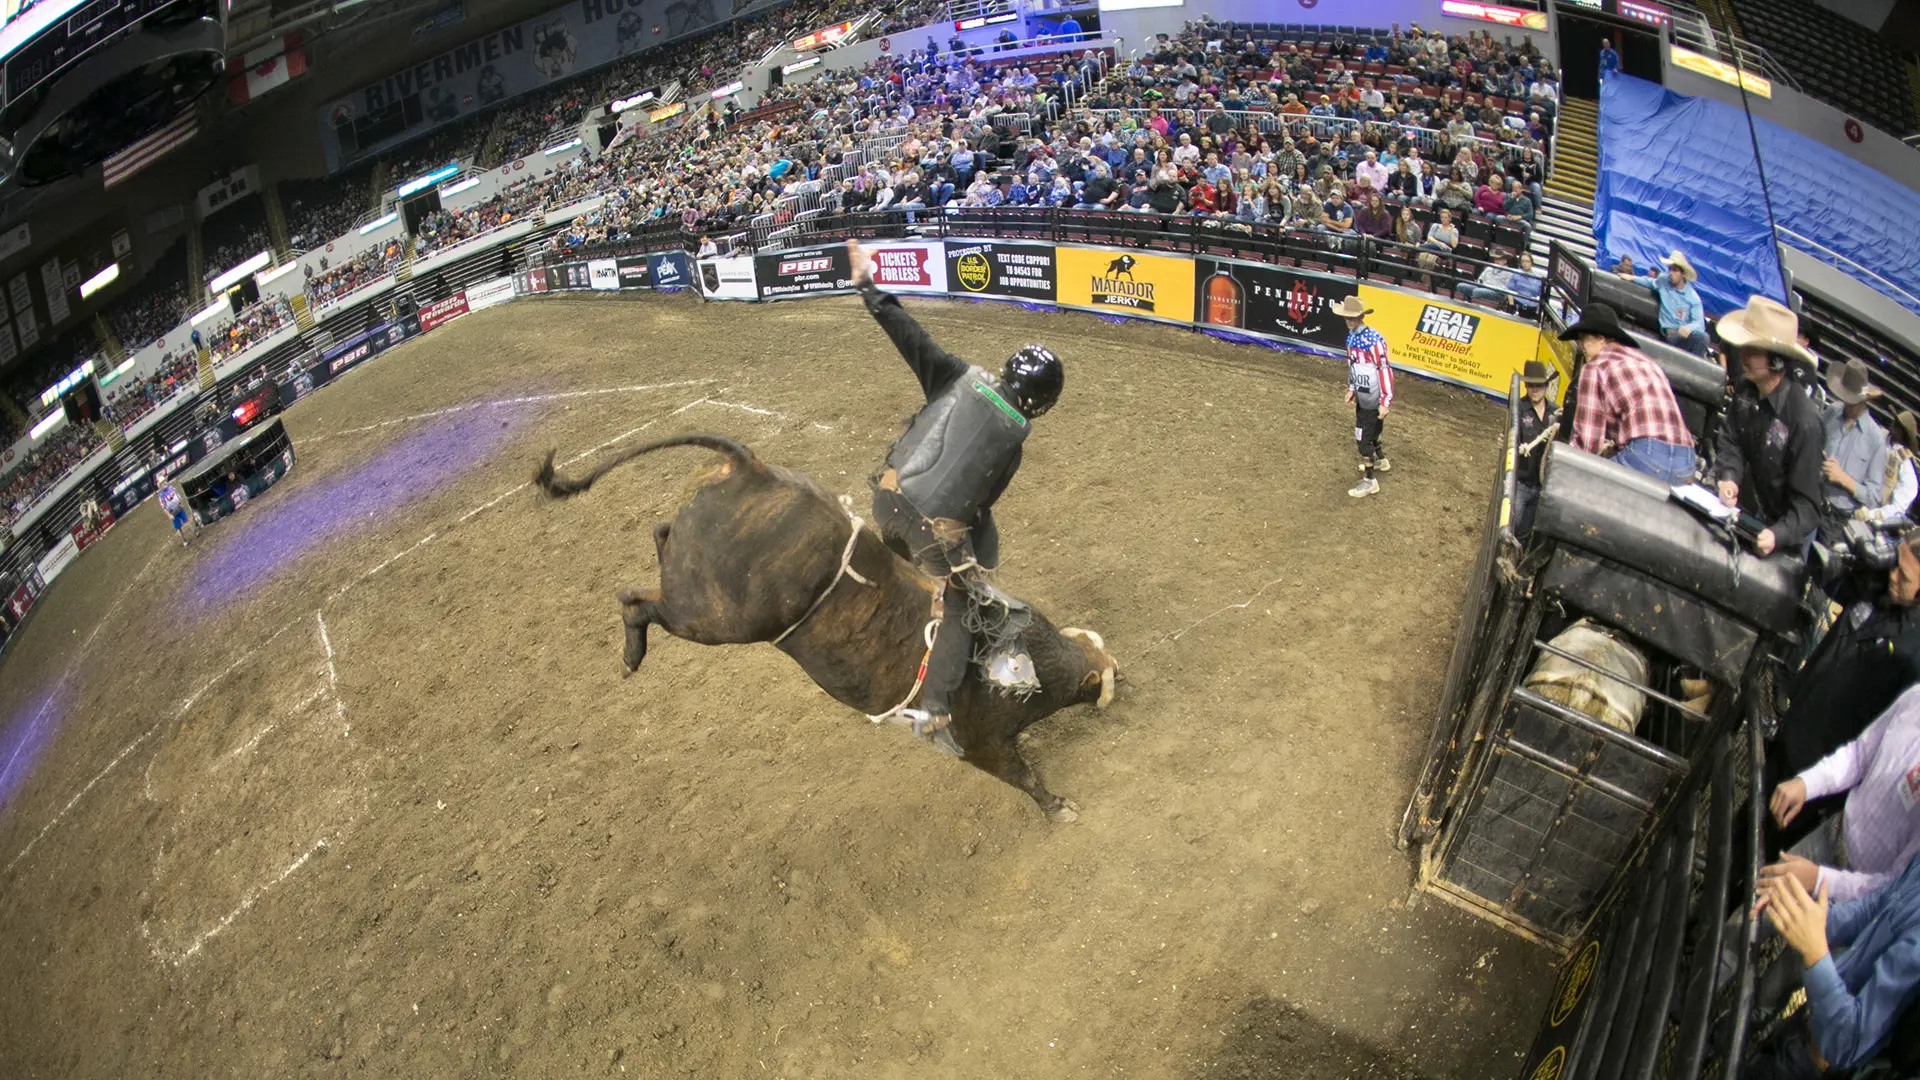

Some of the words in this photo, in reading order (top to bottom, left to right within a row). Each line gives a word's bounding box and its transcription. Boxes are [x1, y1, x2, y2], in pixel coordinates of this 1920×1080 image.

[364, 25, 525, 113] RIVERMEN
[878, 251, 918, 267] TICKETS
[948, 246, 981, 258] PROTECTED
[983, 244, 992, 252] BY
[997, 253, 1010, 263] TEXT
[1011, 255, 1025, 264] CODE
[781, 259, 829, 273] PBR
[966, 256, 978, 264] U.S.
[881, 267, 898, 281] FOR
[961, 265, 986, 273] BORDER
[962, 273, 986, 281] PATROL
[1006, 265, 1013, 275] TO
[1014, 266, 1031, 276] 94543
[1031, 267, 1042, 277] FOR
[1558, 256, 1580, 290] PBR
[794, 274, 820, 282] pbr.com
[1000, 276, 1009, 286] JOB
[1010, 277, 1051, 290] OPPORTUNITIES
[1091, 275, 1155, 300] MATADOR
[432, 296, 458, 312] PBR
[1105, 295, 1140, 307] JERKY
[1278, 301, 1321, 314] WHISKY
[421, 299, 466, 322] Rewards
[1423, 305, 1474, 330] REAL
[1422, 318, 1473, 344] TIME
[1411, 331, 1437, 348] Pain
[1437, 338, 1473, 356] Relief
[332, 344, 369, 372] PBR
[1392, 348, 1401, 356] for
[1408, 353, 1427, 363] FREE
[1427, 357, 1443, 367] Tube
[1453, 364, 1468, 374] Pain
[1405, 344, 1420, 353] Text
[1458, 358, 1481, 369] 90407
[155, 453, 188, 484] PBR
